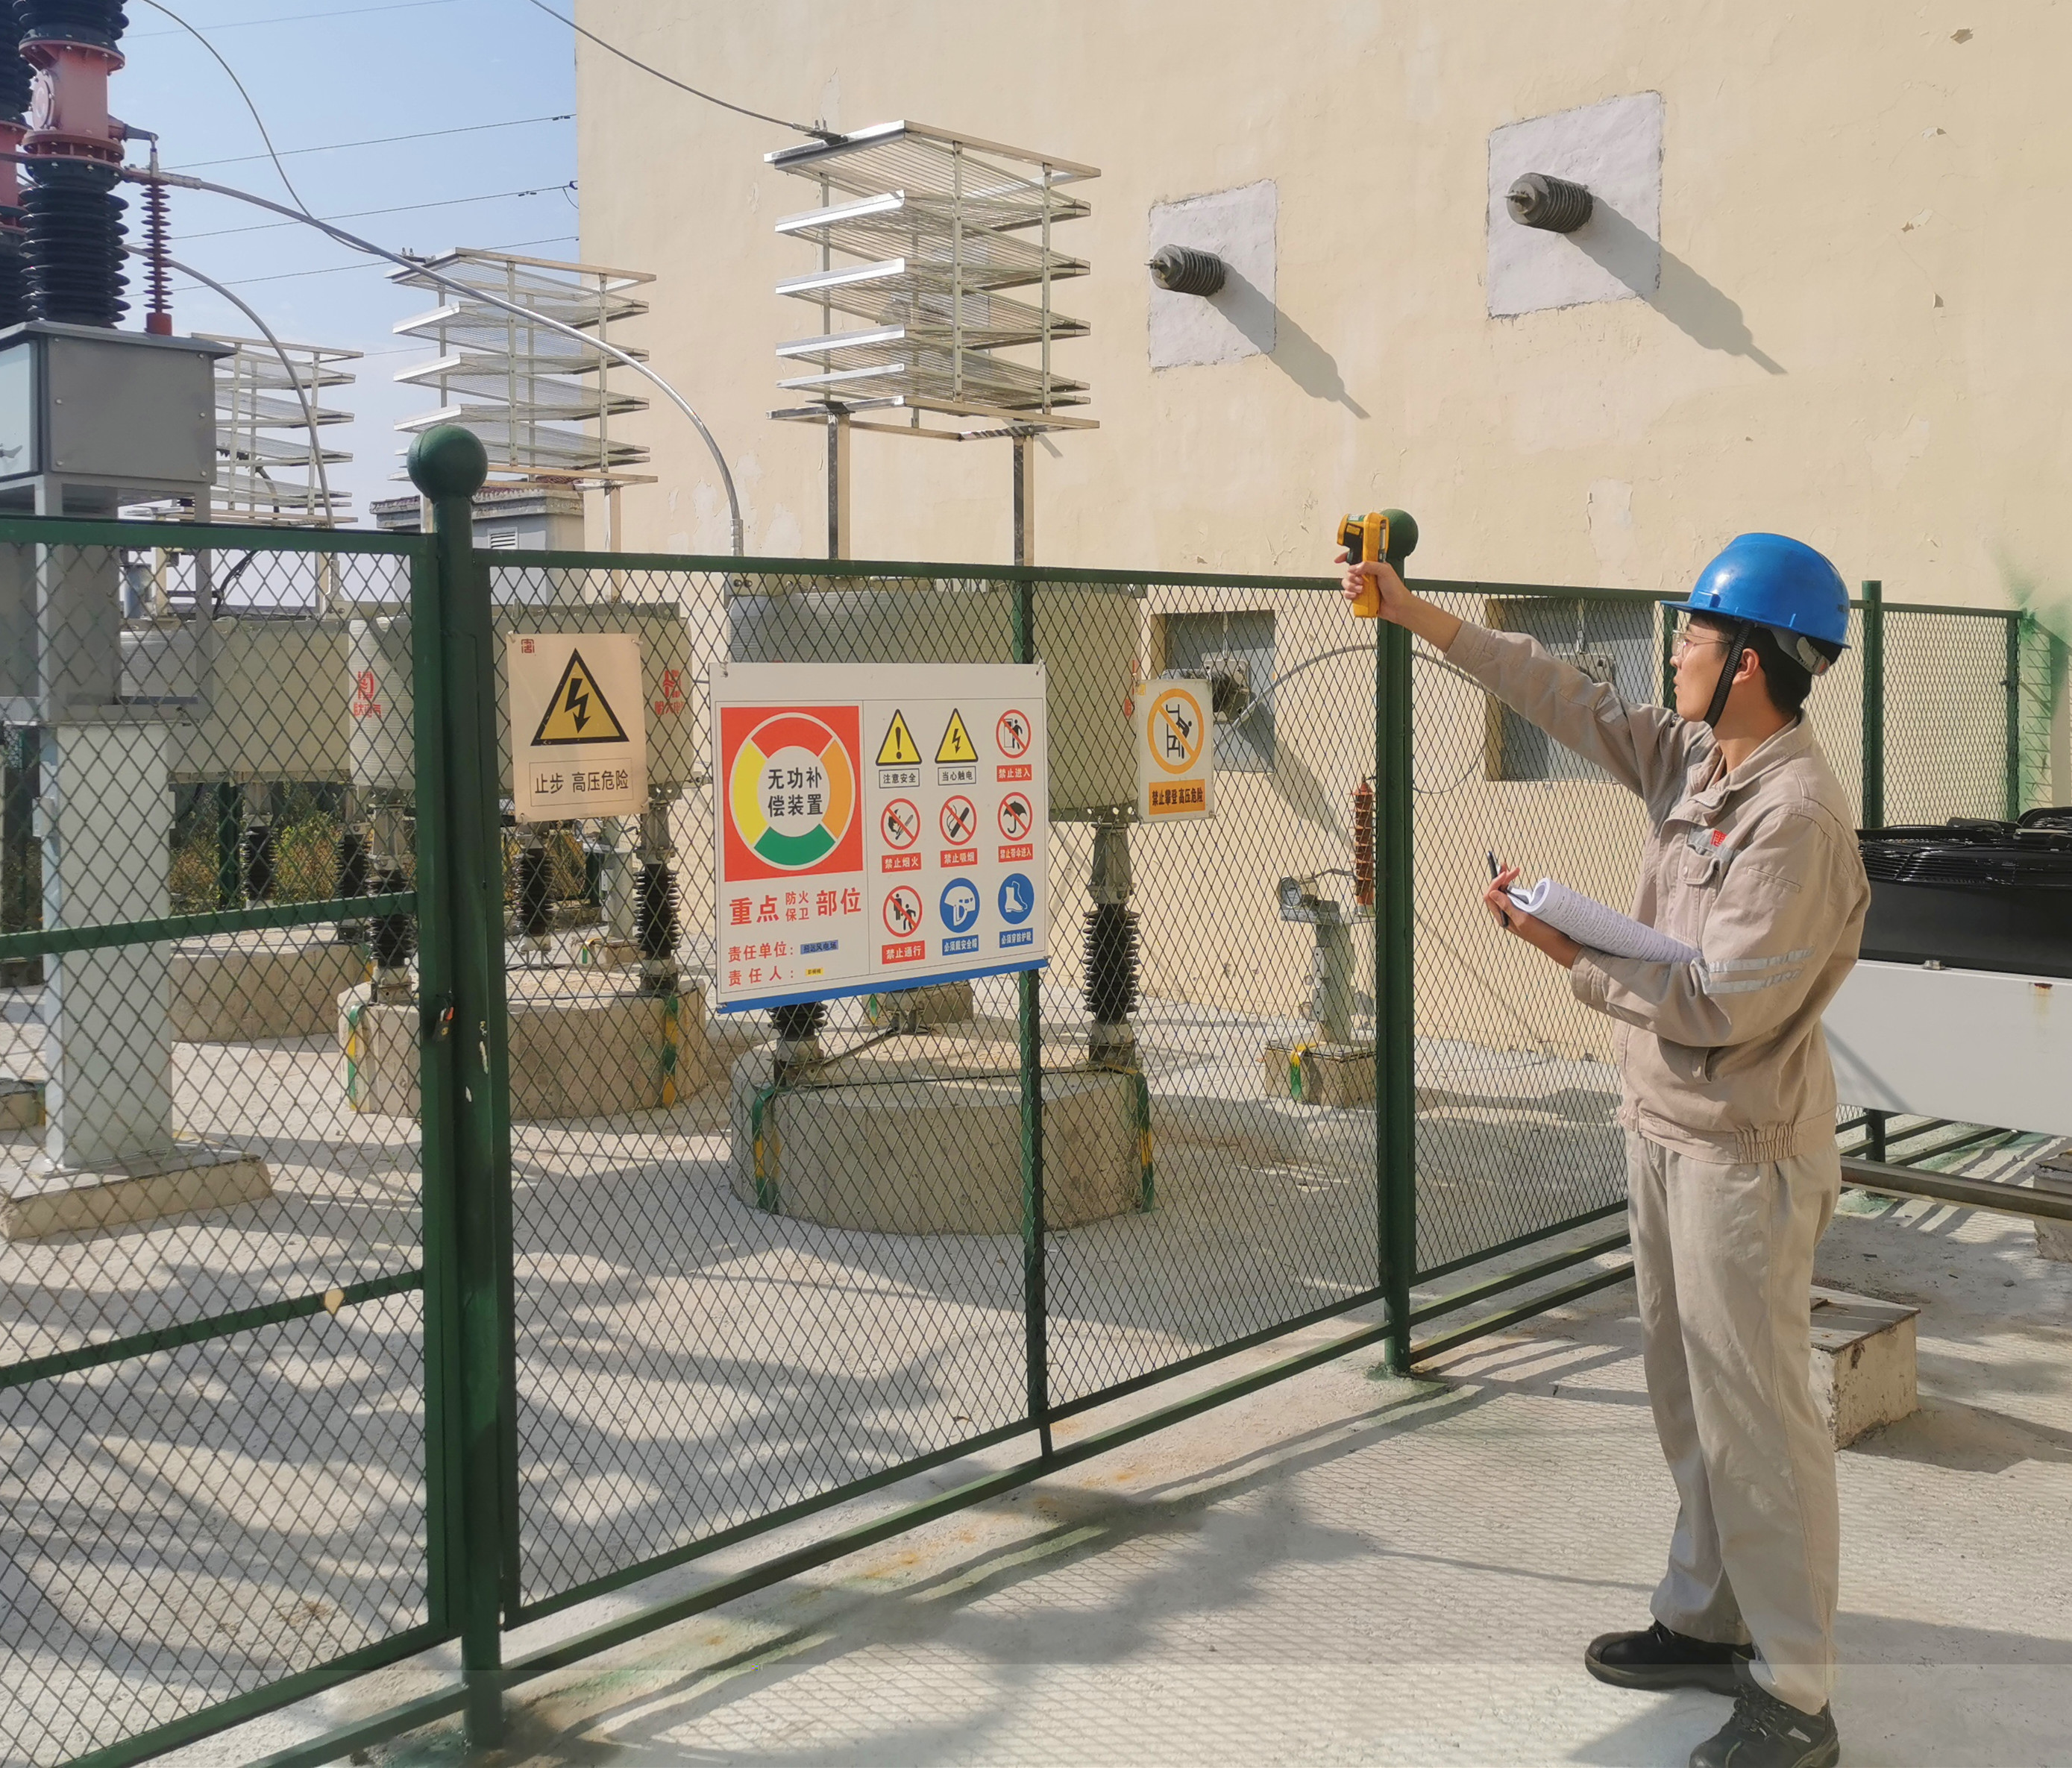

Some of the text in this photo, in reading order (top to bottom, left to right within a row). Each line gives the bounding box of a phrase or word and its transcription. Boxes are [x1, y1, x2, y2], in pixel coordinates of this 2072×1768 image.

[768, 767, 822, 790] 无功补
[883, 773, 916, 784] 注意安全
[942, 770, 973, 781] 当心触电
[998, 767, 1031, 779] 禁止进入
[535, 769, 629, 793] 止步 高压危险
[1152, 787, 1203, 806] 禁止攀登 高压危险
[767, 793, 823, 817] 偿装置
[944, 852, 975, 865] 禁止吸烟
[999, 847, 1032, 859] 禁止带伞进入
[885, 856, 919, 869] 禁止烟火
[785, 890, 809, 905] 防火
[816, 887, 861, 916] 部位
[729, 895, 779, 925] 重点
[785, 907, 809, 922] 保卫
[944, 938, 977, 952] 必须戴安全帽
[886, 946, 921, 960] 禁止通行
